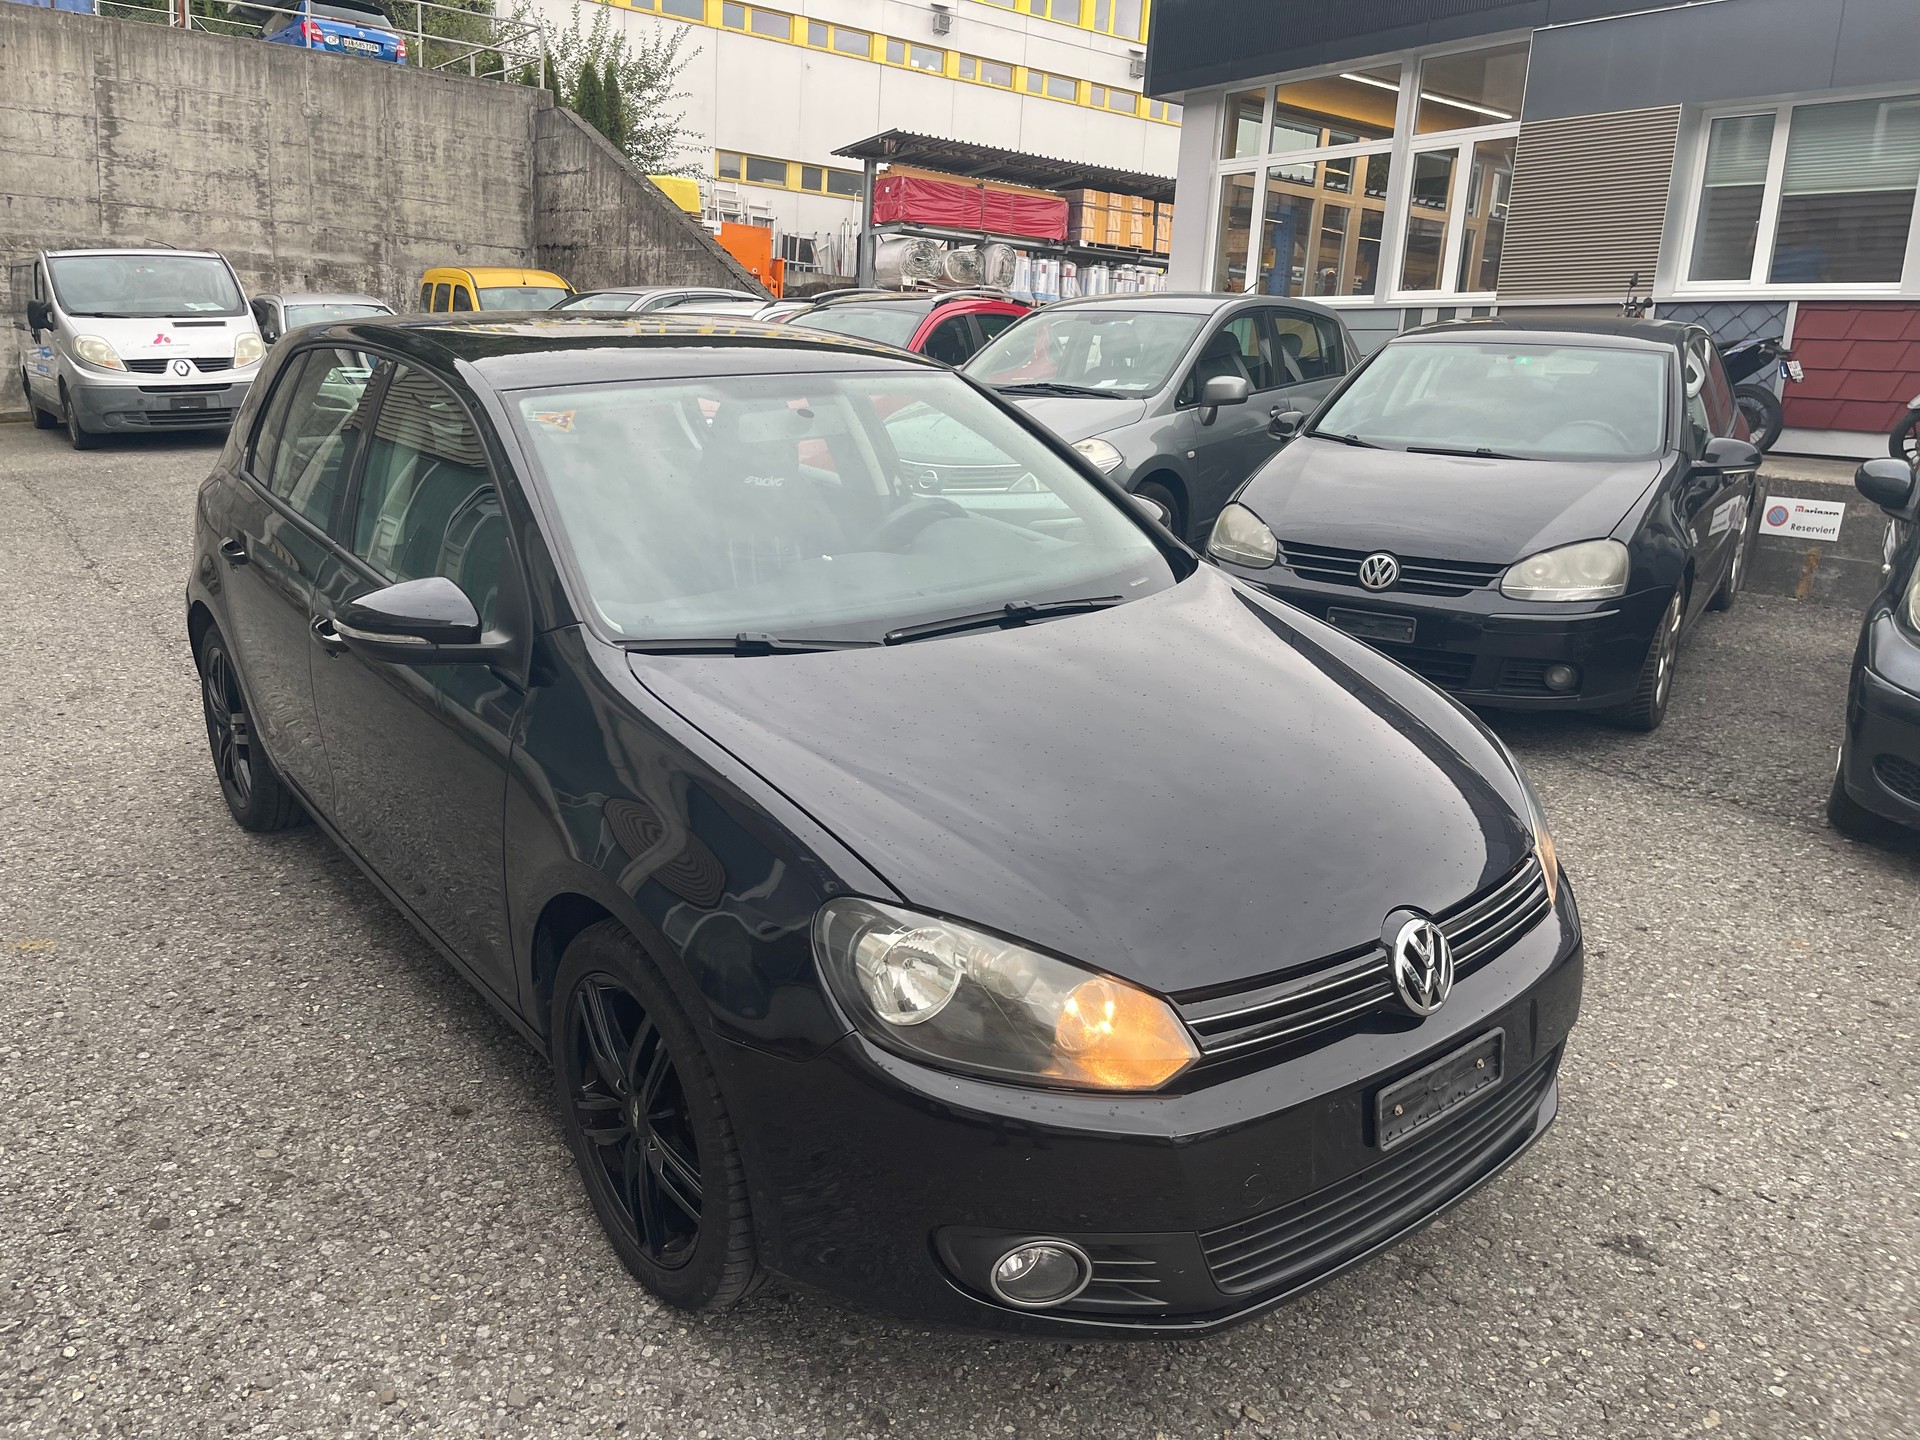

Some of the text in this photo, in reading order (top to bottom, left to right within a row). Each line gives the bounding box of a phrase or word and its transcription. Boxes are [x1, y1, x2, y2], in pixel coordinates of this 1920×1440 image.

[1790, 523, 1836, 535] Reserviert
[1360, 553, 1397, 589] VW
[1394, 918, 1454, 1016] VW
